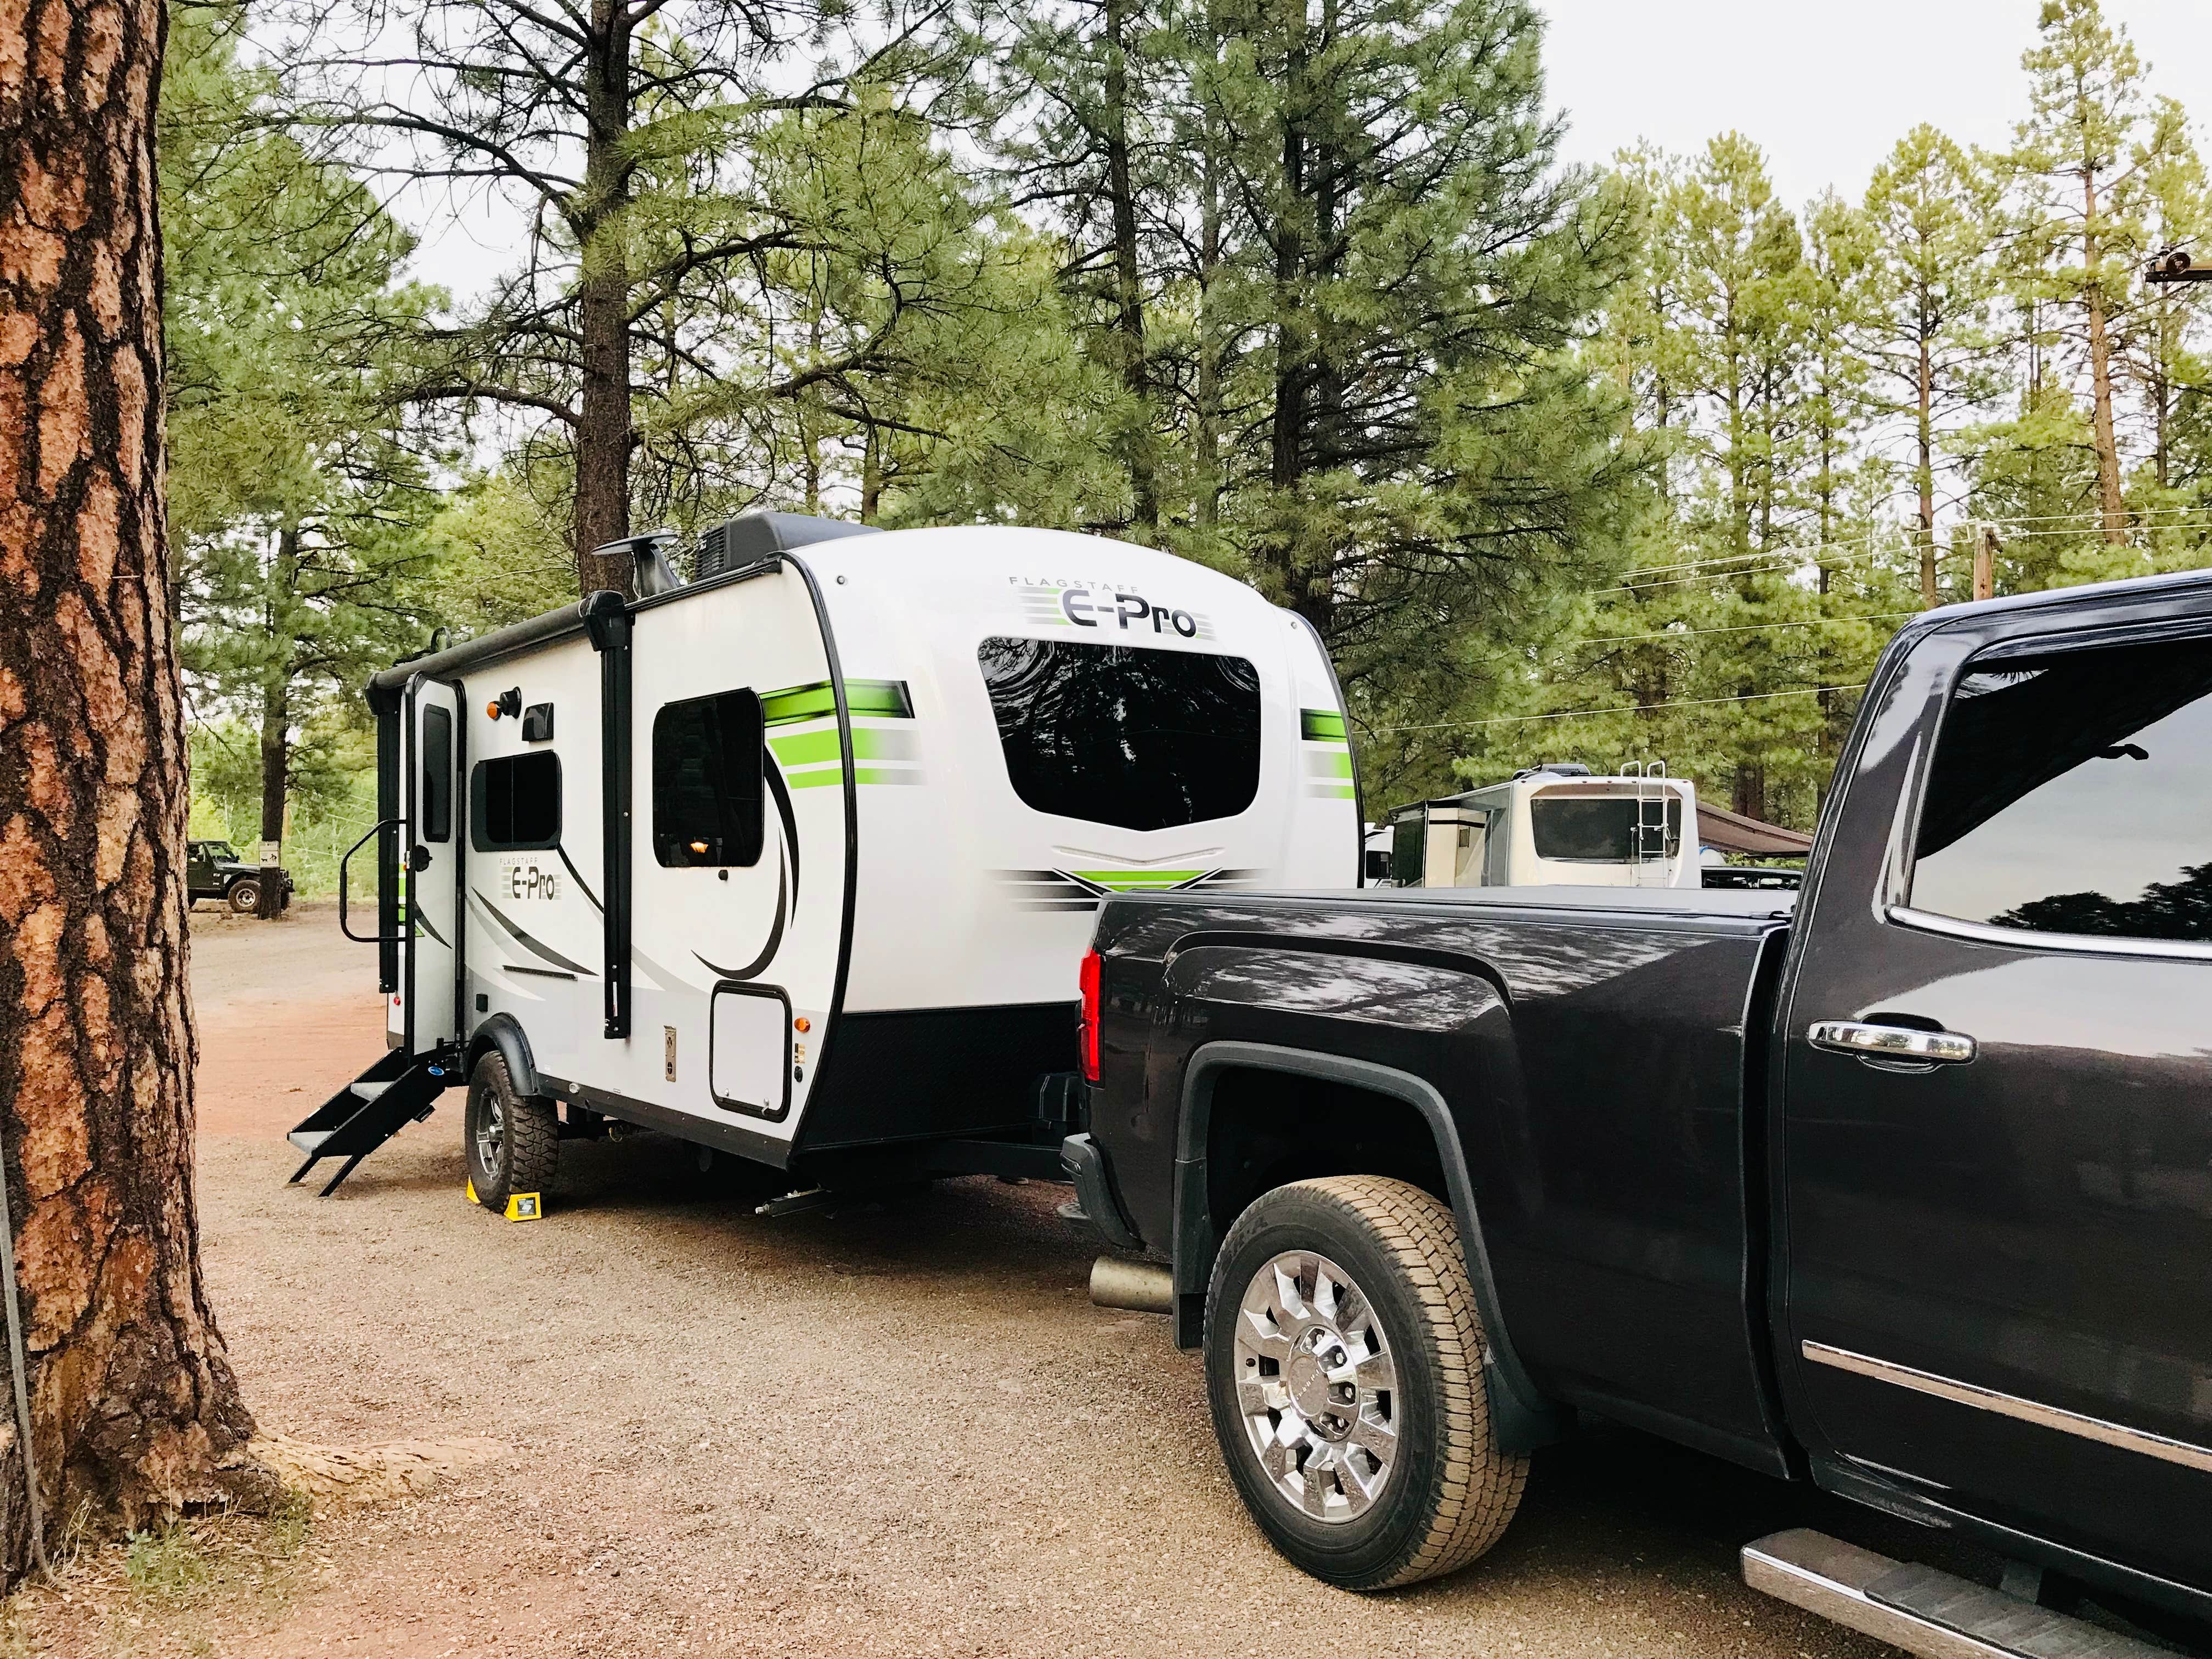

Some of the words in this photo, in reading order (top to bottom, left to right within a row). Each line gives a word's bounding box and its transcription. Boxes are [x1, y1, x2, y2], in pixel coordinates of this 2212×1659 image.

[1009, 577, 1138, 594] FLAGSTAFF
[1062, 589, 1197, 637] E-Pro
[500, 857, 538, 865] FLAGSTAFF
[512, 866, 555, 900] E-Pro
